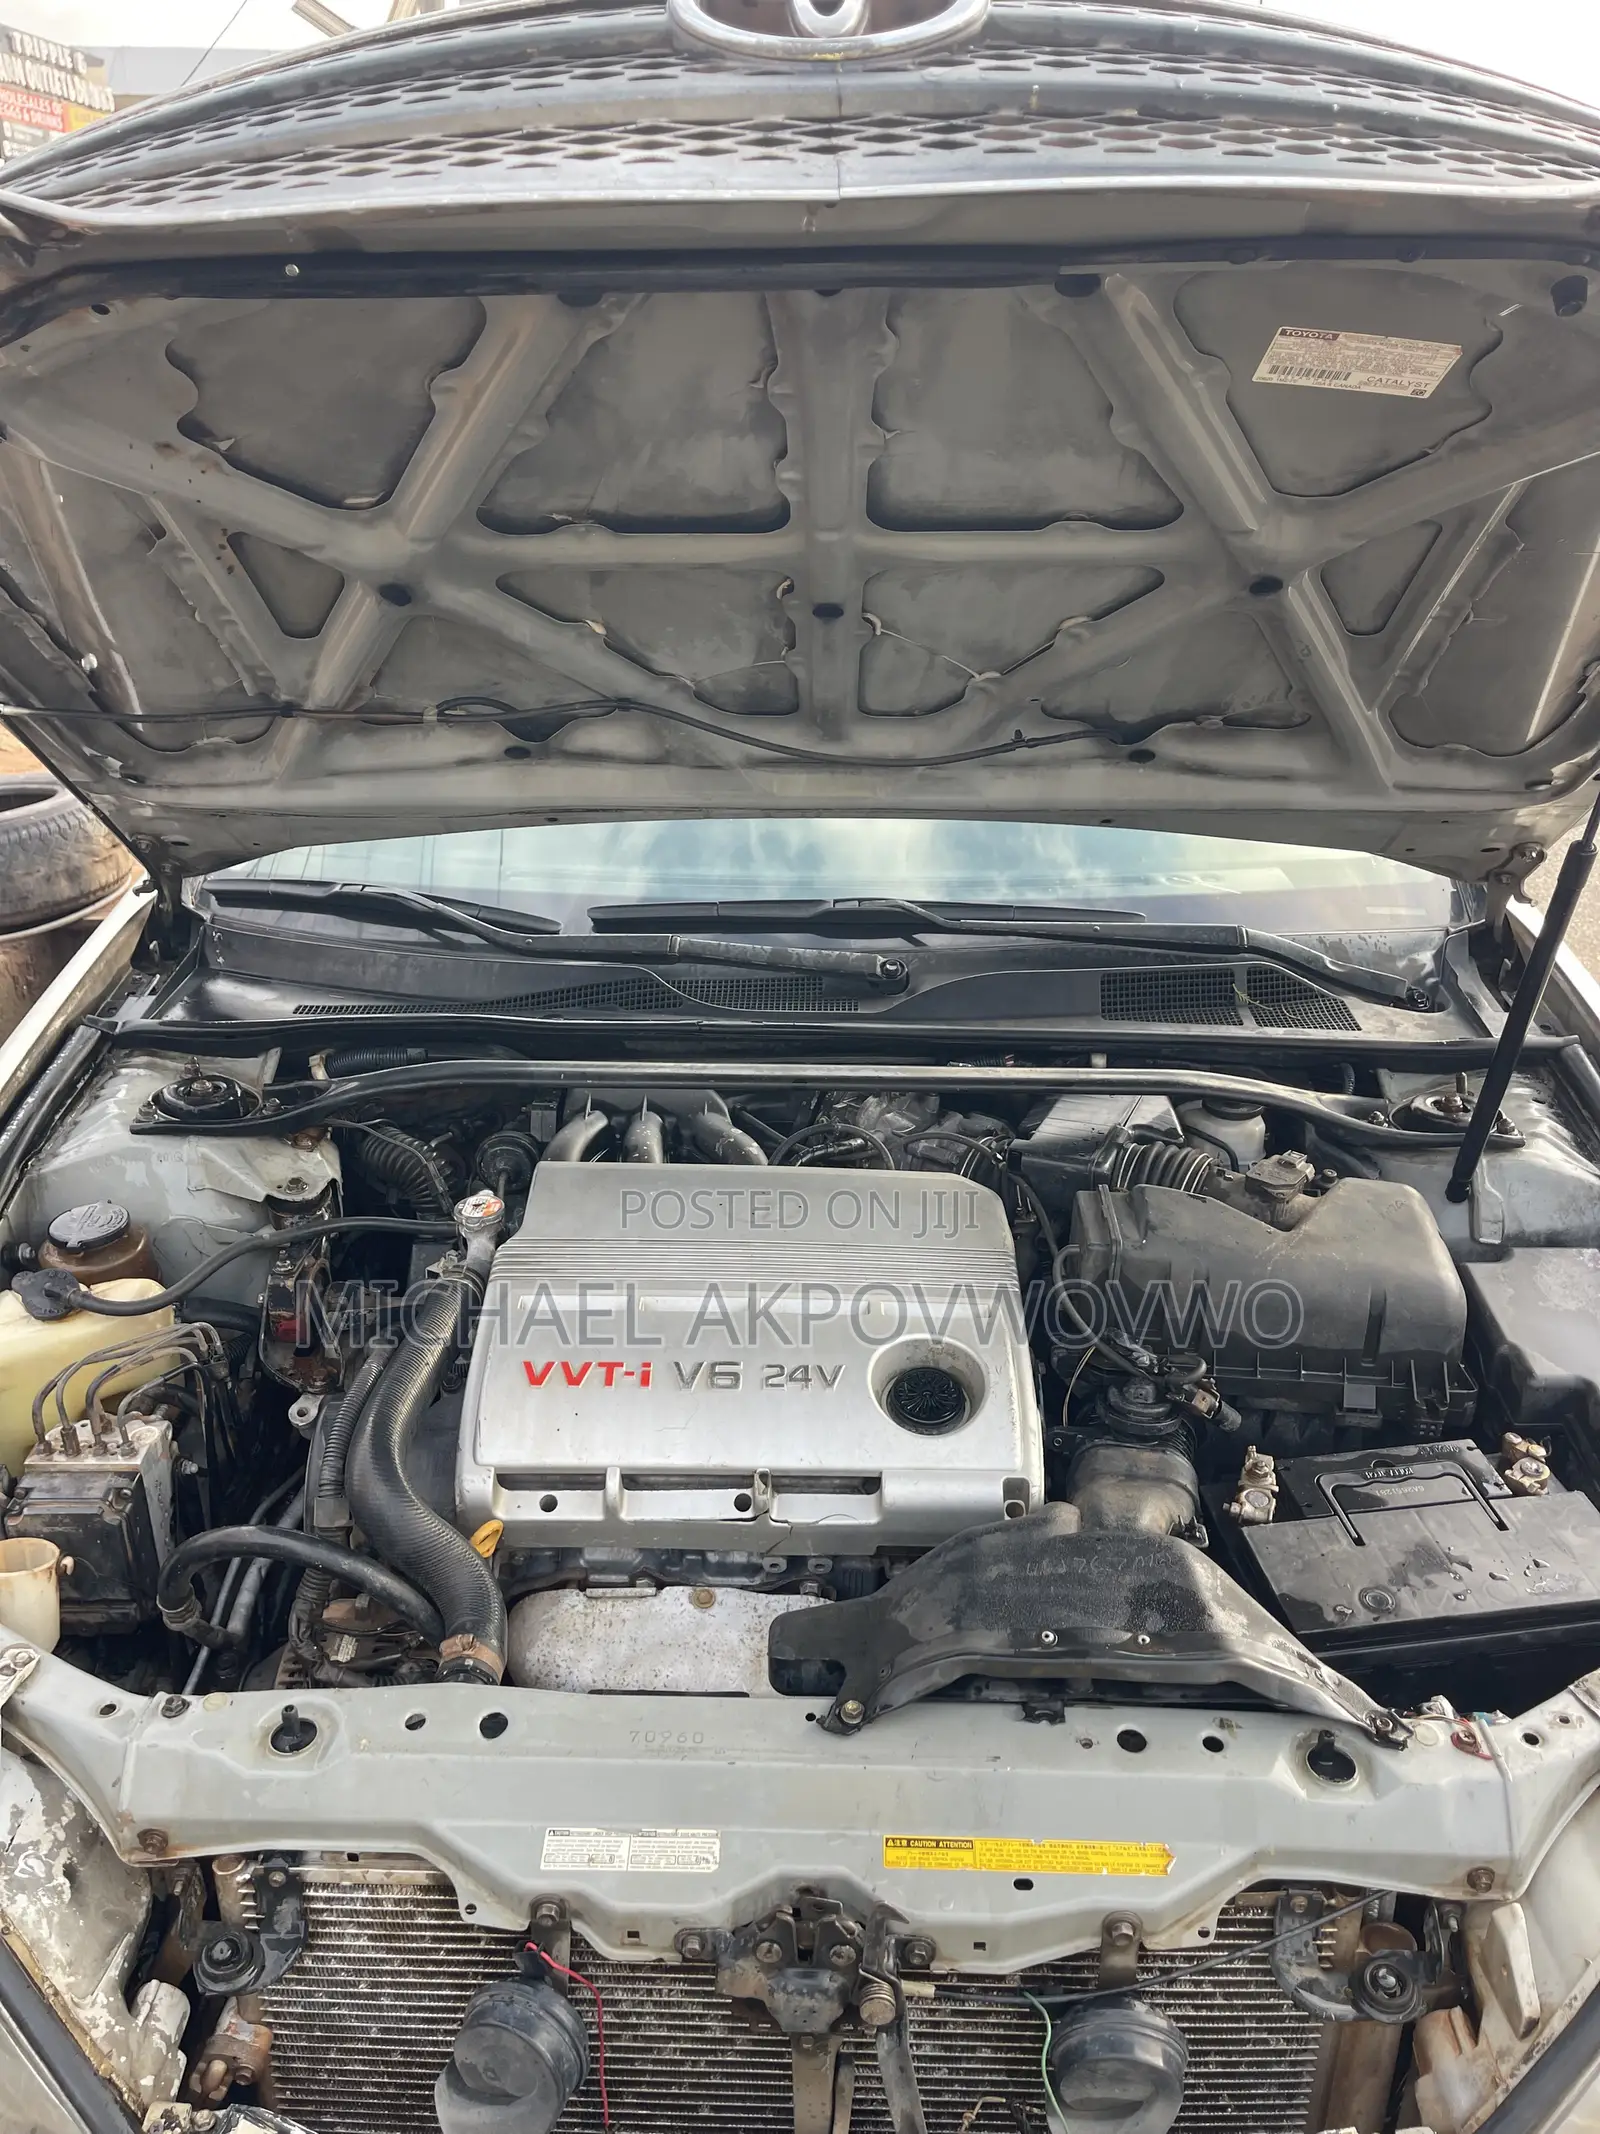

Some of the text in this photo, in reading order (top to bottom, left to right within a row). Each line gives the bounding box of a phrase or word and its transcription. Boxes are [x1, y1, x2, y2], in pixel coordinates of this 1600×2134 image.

[1285, 329, 1334, 341] TOYOTA
[1366, 376, 1431, 389] CATALYST
[523, 1360, 846, 1392] VVT-i V6 24V
[629, 1729, 704, 1745] 70960
[909, 1840, 973, 1849] CAUTION ATTENTION
